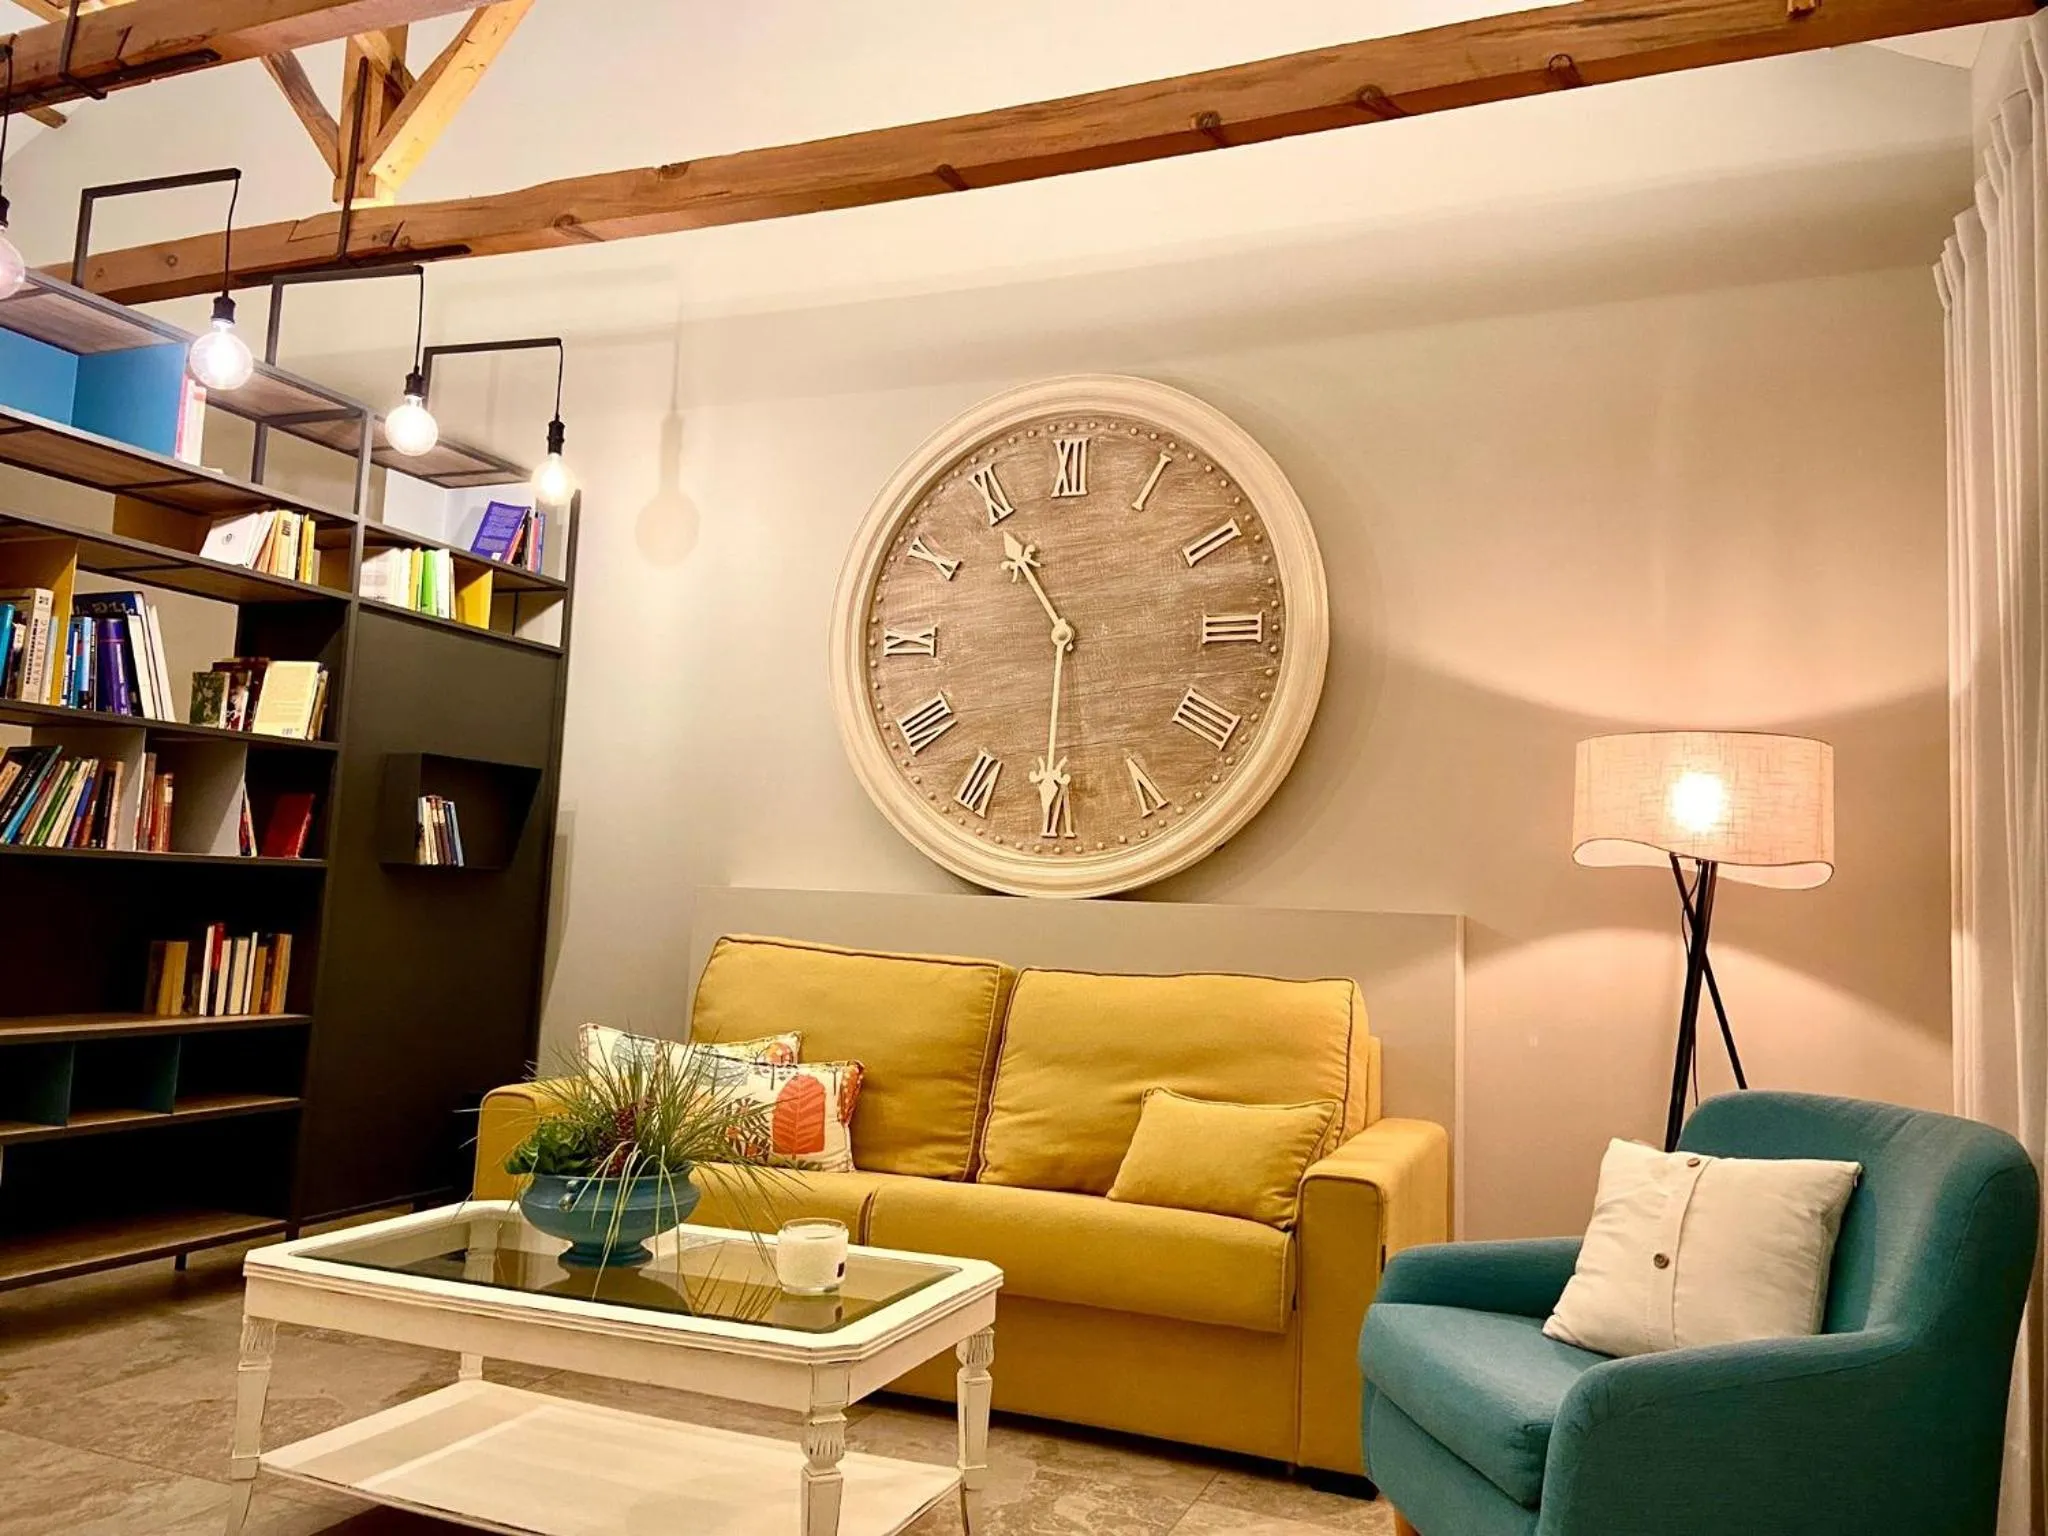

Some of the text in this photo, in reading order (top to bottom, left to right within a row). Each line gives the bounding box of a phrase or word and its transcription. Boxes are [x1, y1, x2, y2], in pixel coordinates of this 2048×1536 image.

[967, 463, 1016, 526] XI
[1051, 437, 1091, 499] XII
[1132, 453, 1172, 512] I
[905, 536, 962, 581] X
[1181, 518, 1243, 567] II
[883, 625, 938, 658] IX
[1201, 611, 1263, 644] III
[896, 690, 957, 756] VIII
[1172, 687, 1242, 752] IIII
[954, 750, 1003, 819] VII
[1124, 755, 1169, 818] V
